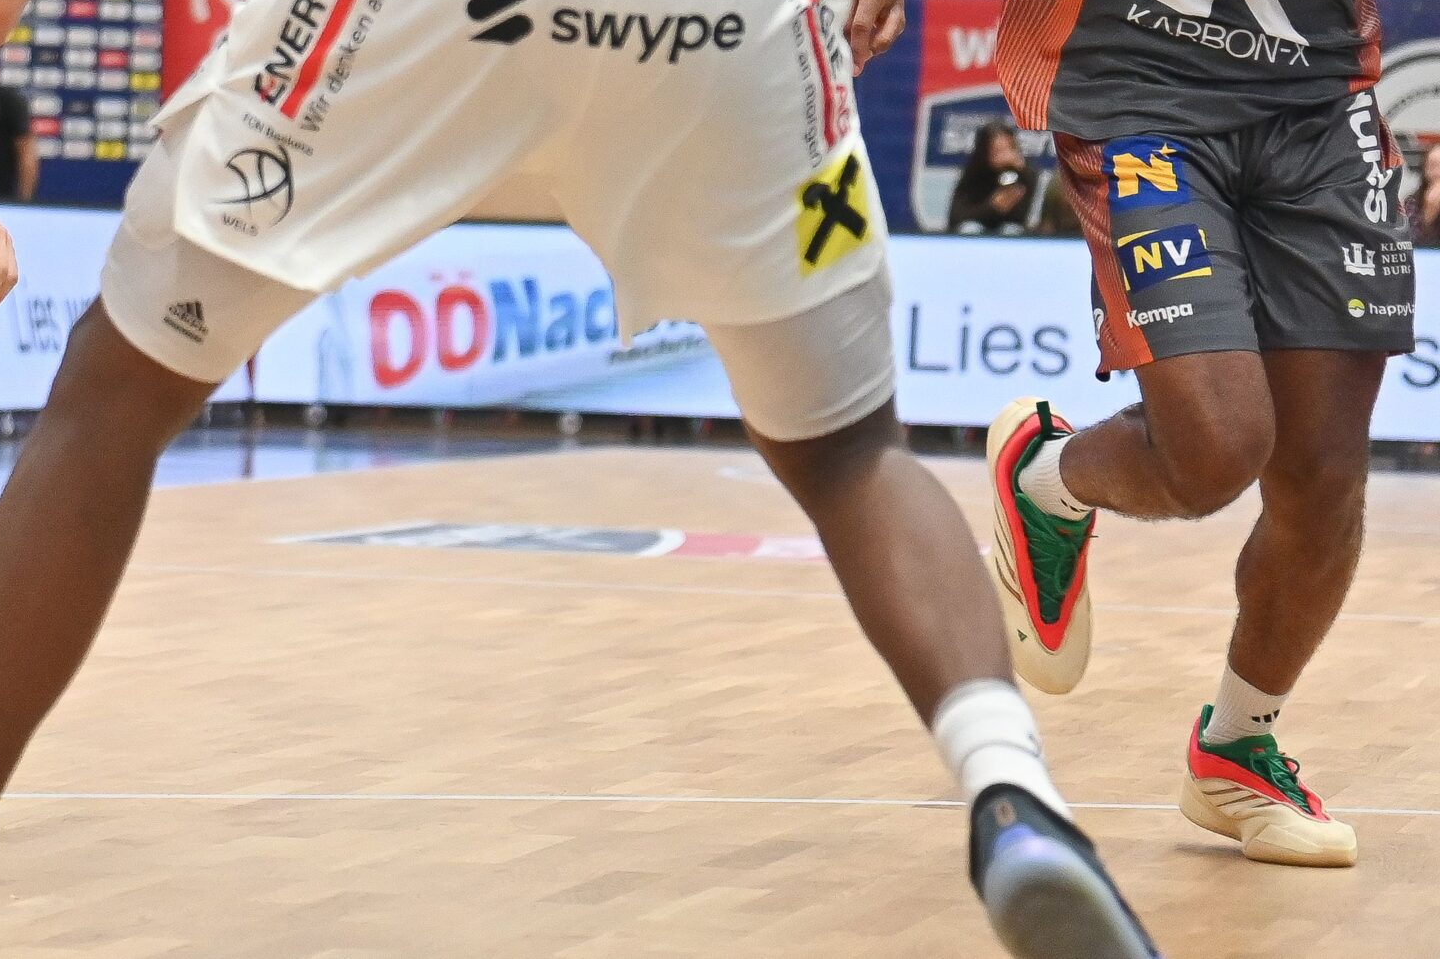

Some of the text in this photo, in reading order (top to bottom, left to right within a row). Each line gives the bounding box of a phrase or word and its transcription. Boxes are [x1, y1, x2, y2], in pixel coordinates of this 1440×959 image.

[326, 15, 375, 94] denken
[551, 5, 746, 64] swype
[1126, 3, 1310, 67] KARBON-X
[1132, 238, 1192, 274] NV
[1381, 254, 1407, 264] NEU
[907, 303, 1071, 376] Lies
[1125, 303, 1194, 329] Kempa
